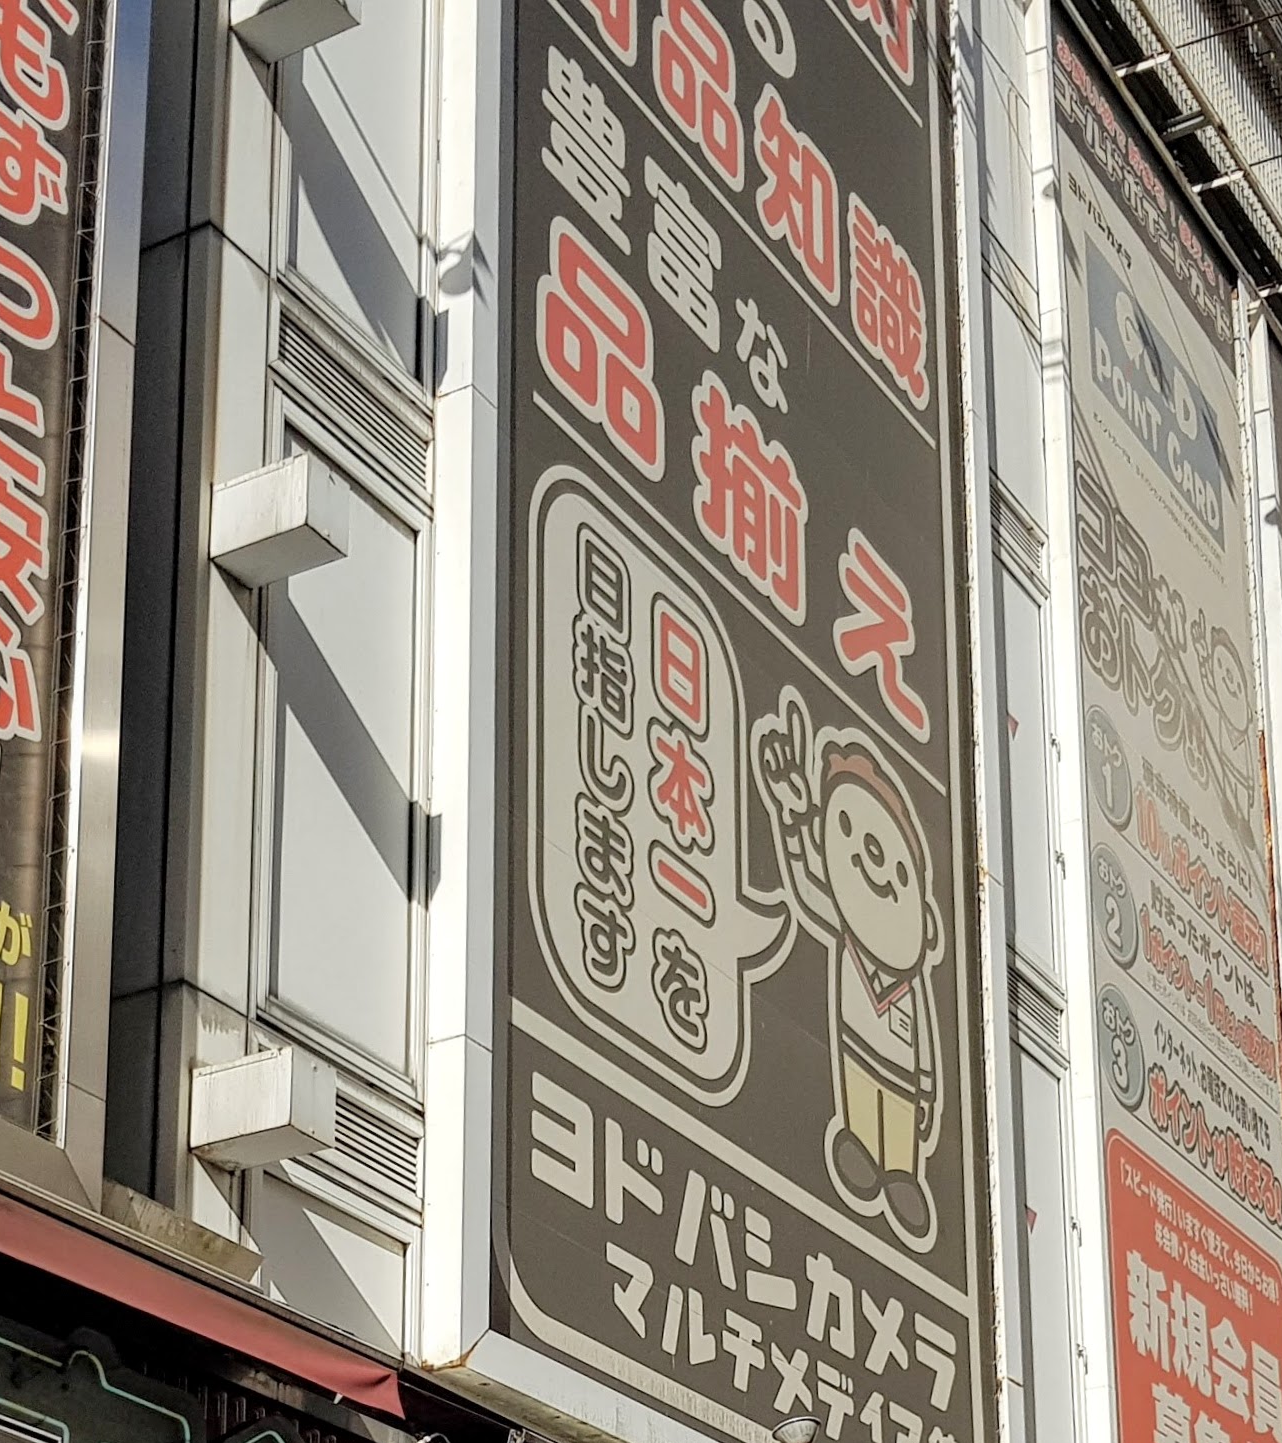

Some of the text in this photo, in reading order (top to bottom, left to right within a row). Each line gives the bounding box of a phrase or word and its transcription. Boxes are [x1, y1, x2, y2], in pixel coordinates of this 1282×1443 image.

[541, 45, 791, 415] 豊富な
[1053, 64, 1235, 345] ゴールドポイントカード
[1068, 172, 1132, 270] ヨドバシカメラ
[534, 213, 921, 742] 品揃え
[1093, 325, 1164, 453] POINT
[1166, 430, 1221, 532] CARD
[571, 521, 637, 996] 目指します
[646, 590, 718, 1056] 日本一を
[1112, 1034, 1130, 1094] 3
[530, 1070, 958, 1413] ヨドバシカメラ
